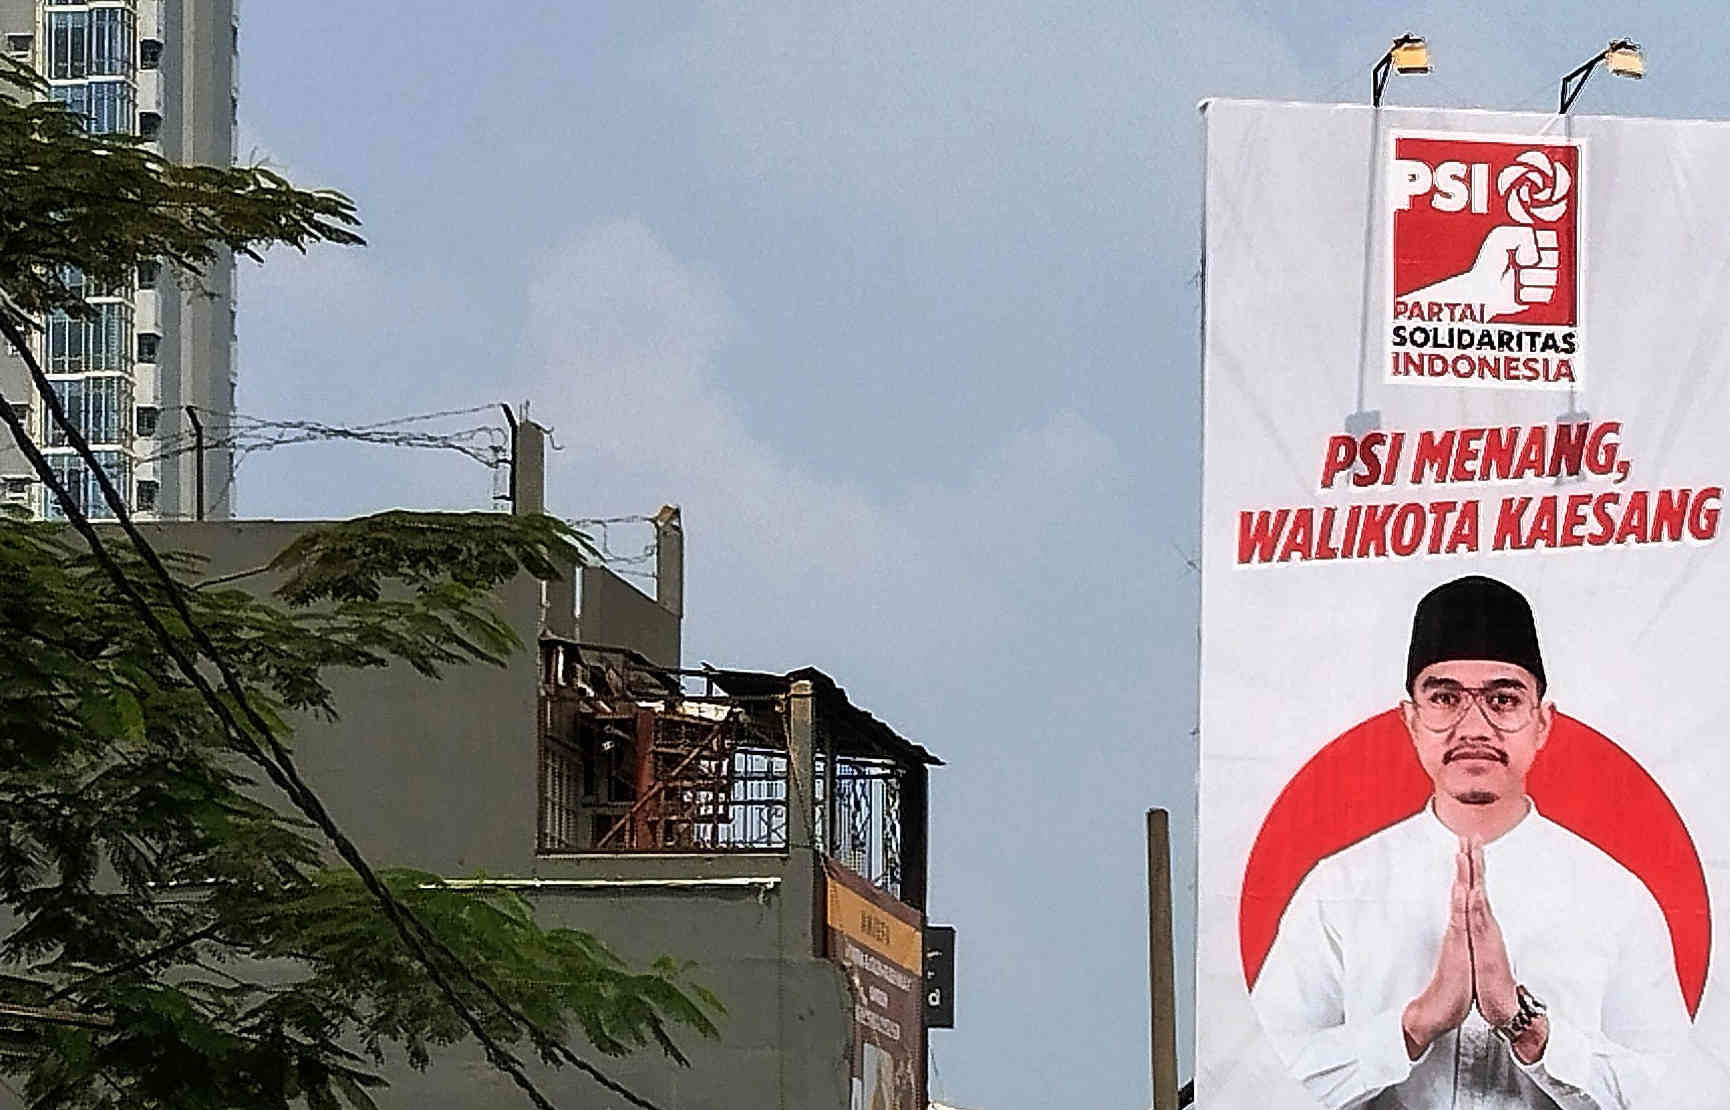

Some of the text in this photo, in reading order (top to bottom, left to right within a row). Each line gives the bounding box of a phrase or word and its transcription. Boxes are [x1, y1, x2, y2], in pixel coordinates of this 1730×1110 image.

[1393, 160, 1489, 214] PSI
[1394, 300, 1486, 323] PARTAI
[1392, 325, 1577, 355] SOLIDARITAS
[1392, 353, 1576, 382] INDONESIA
[1321, 421, 1631, 488] PSI MENANG,
[1237, 487, 1723, 564] WALIKOTA KAESANG
